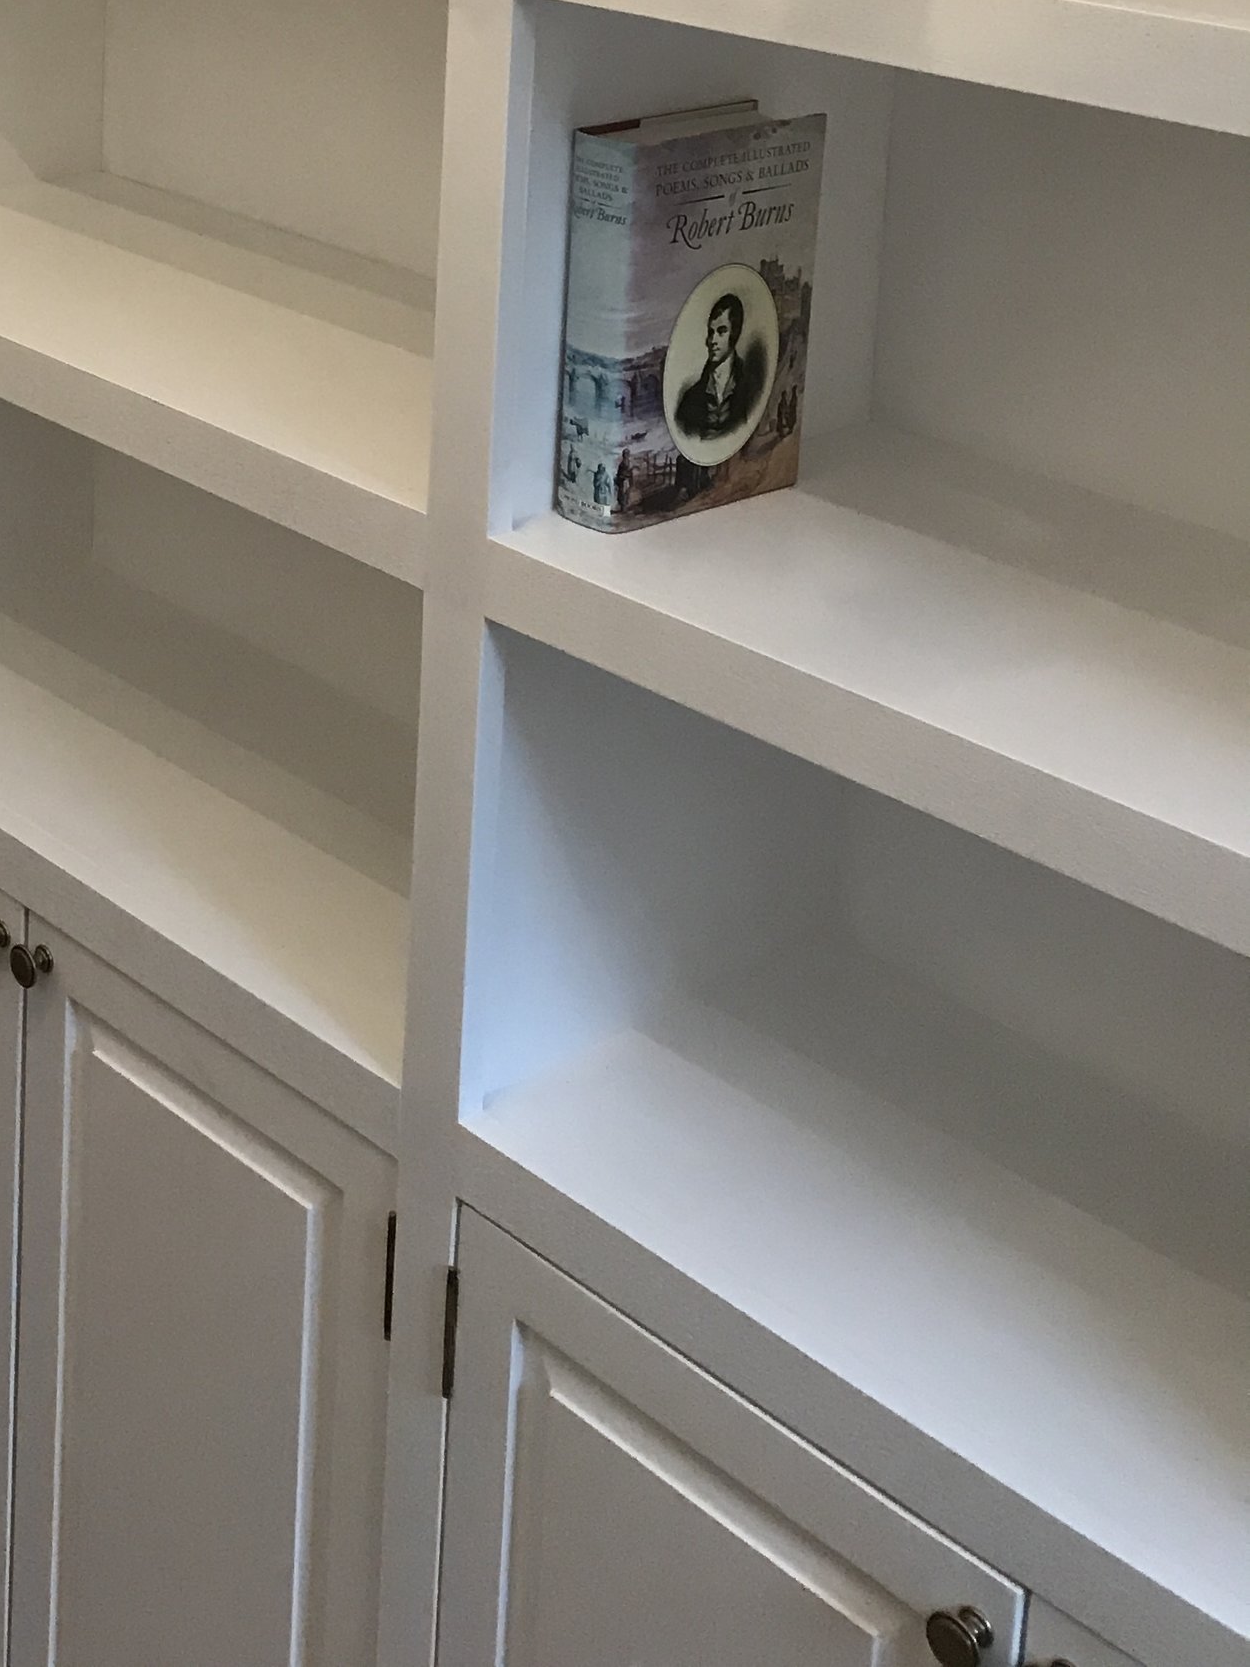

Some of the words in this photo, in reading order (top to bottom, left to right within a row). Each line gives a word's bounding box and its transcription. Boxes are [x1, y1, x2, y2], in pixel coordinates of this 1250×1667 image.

[656, 163, 679, 177] THE
[682, 153, 739, 173] COMPLETE
[741, 141, 811, 162] ILLUSTRATED
[655, 178, 700, 197] POEMS,
[703, 171, 742, 188] SONGS
[745, 172, 755, 181] &
[758, 159, 810, 179] BALLADS
[596, 207, 628, 226] Burns
[666, 208, 736, 250] Robert
[738, 201, 795, 231] Burns
